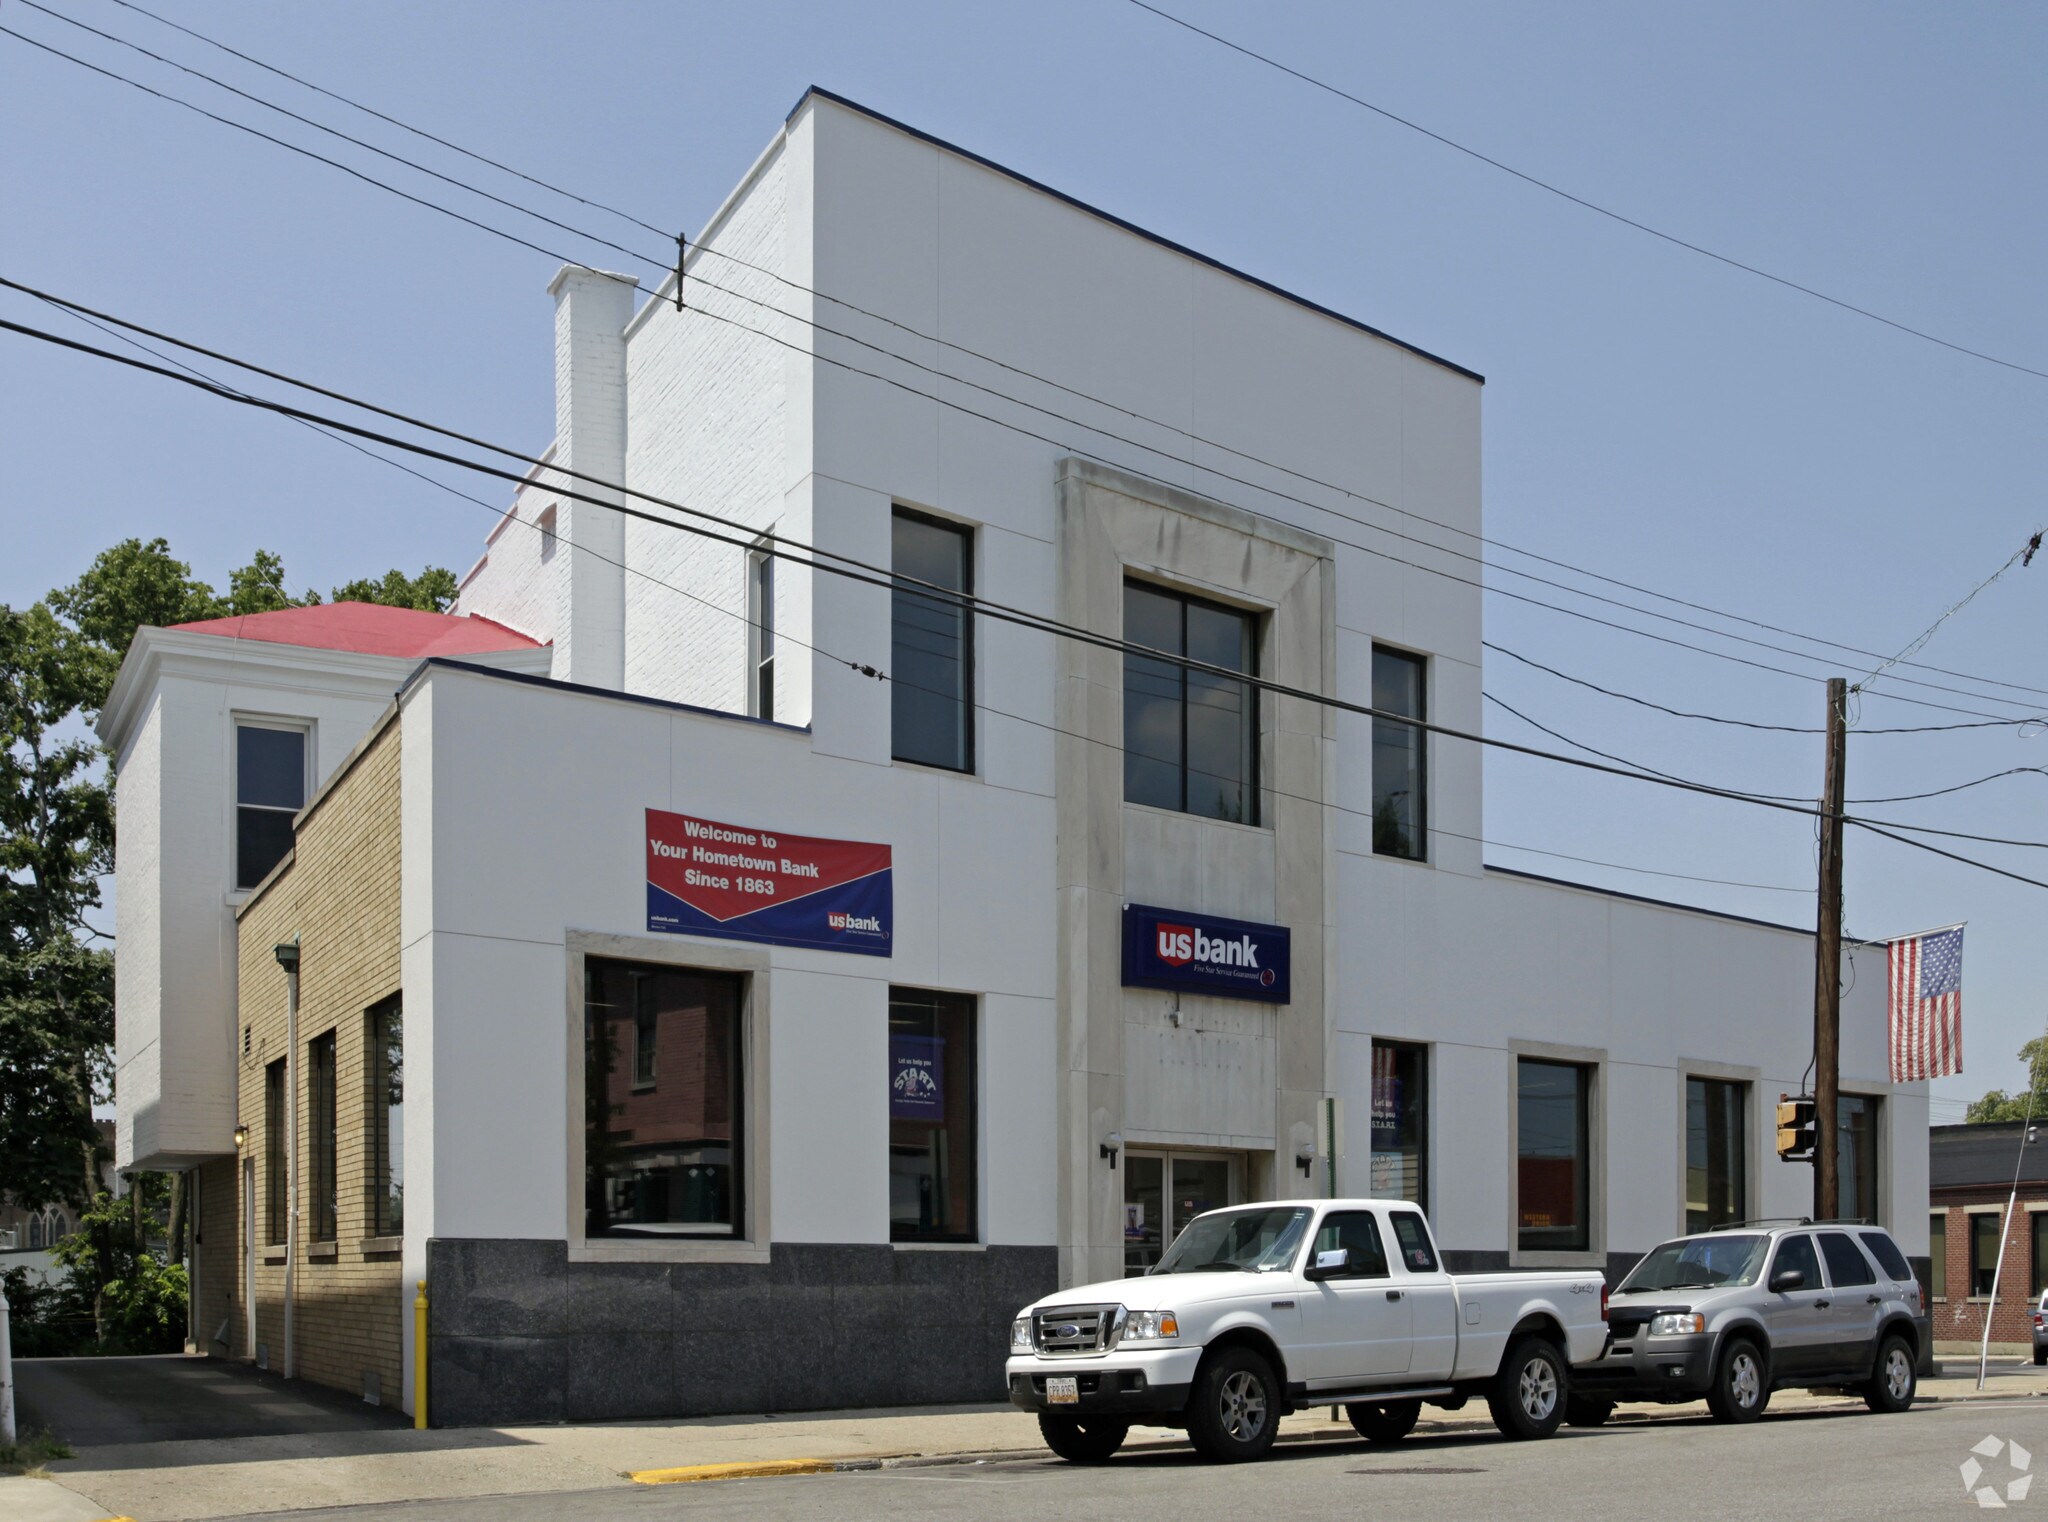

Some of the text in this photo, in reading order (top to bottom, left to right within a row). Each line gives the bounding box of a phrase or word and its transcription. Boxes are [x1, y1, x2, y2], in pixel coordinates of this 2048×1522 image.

[684, 820, 777, 849] Welcome to
[650, 839, 819, 878] Your Hometown Bank
[684, 869, 775, 895] Since 1863
[1193, 964, 1205, 973] Five
[1205, 965, 1215, 974] Star
[1215, 967, 1232, 976] Service
[912, 1058, 923, 1066] help
[894, 1067, 936, 1091] START
[1374, 1098, 1384, 1107] Let
